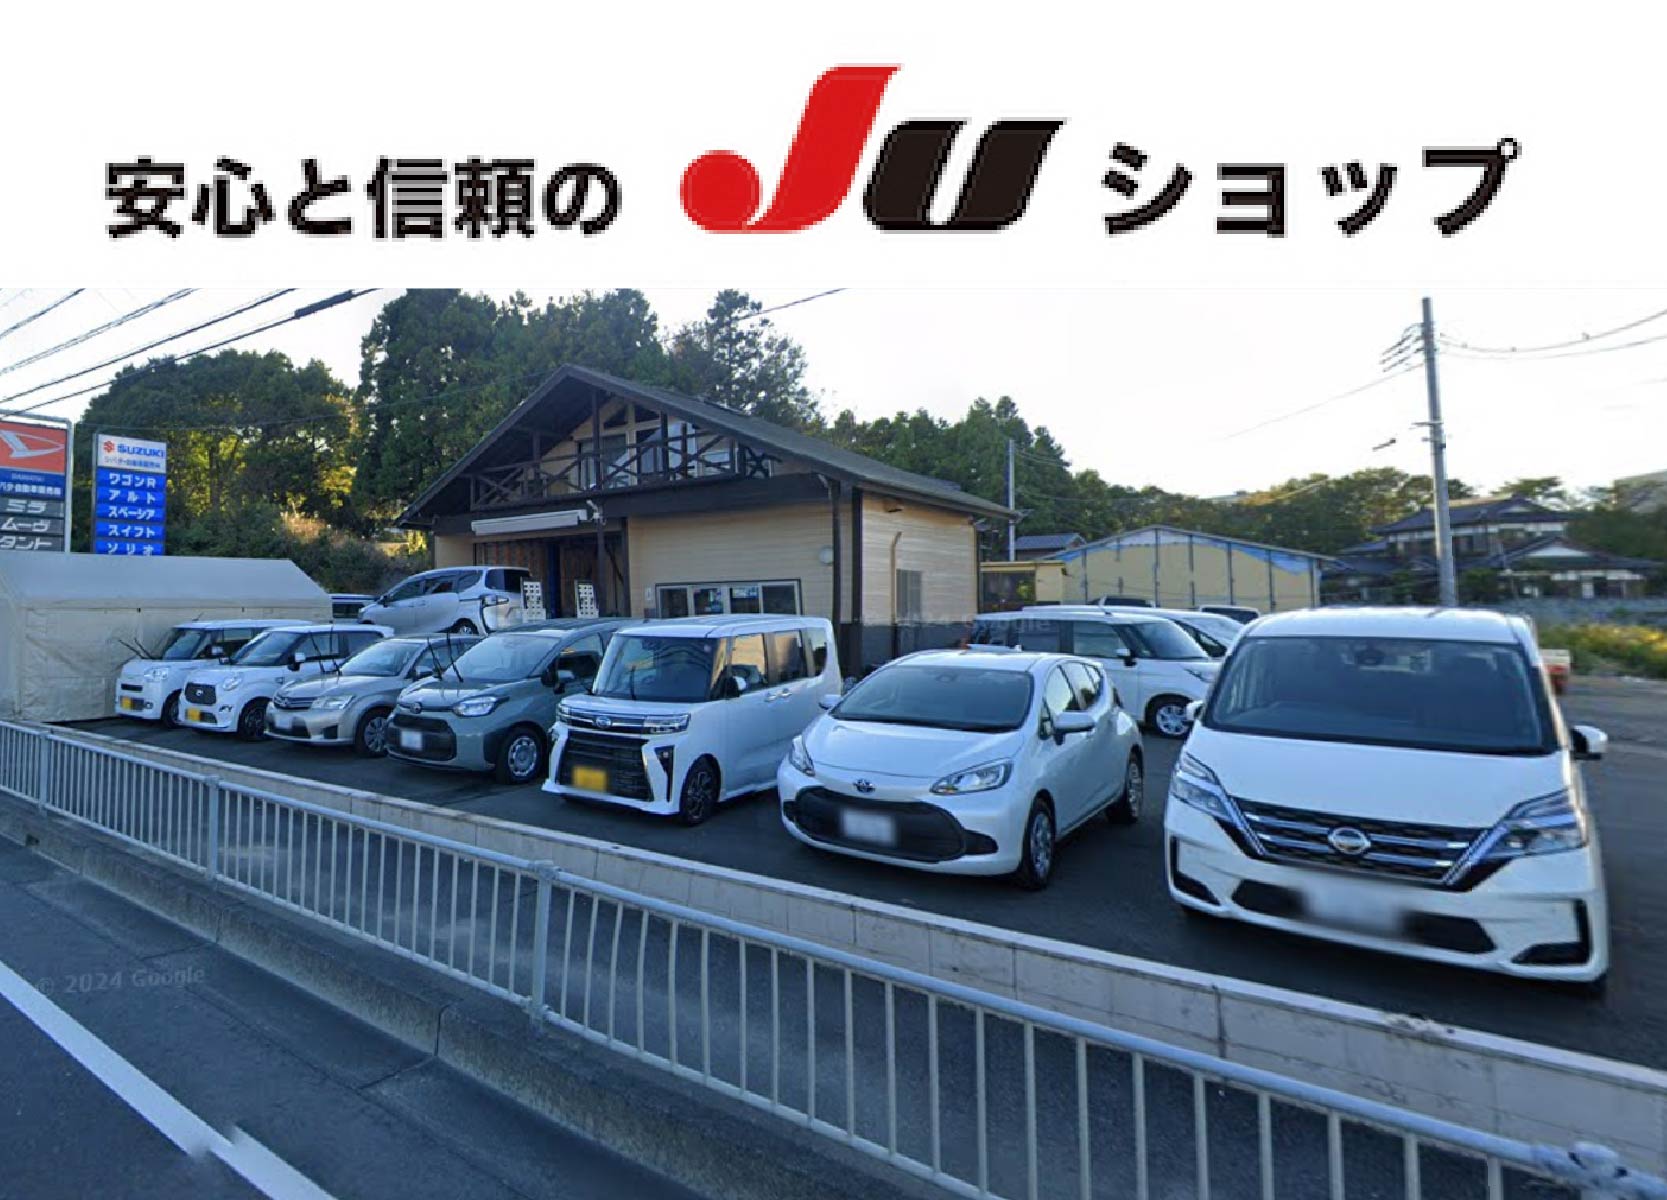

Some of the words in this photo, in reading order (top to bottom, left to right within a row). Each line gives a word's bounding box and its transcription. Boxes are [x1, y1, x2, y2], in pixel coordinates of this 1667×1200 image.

[117, 443, 165, 458] SUZUKI
[109, 473, 156, 488] ワゴンR
[109, 489, 156, 505] アルト
[6, 499, 47, 513] ミラ
[108, 505, 156, 520] スペーシア
[108, 524, 156, 538] スイフト
[0, 535, 52, 550] タント
[107, 542, 154, 555] ソリオ
